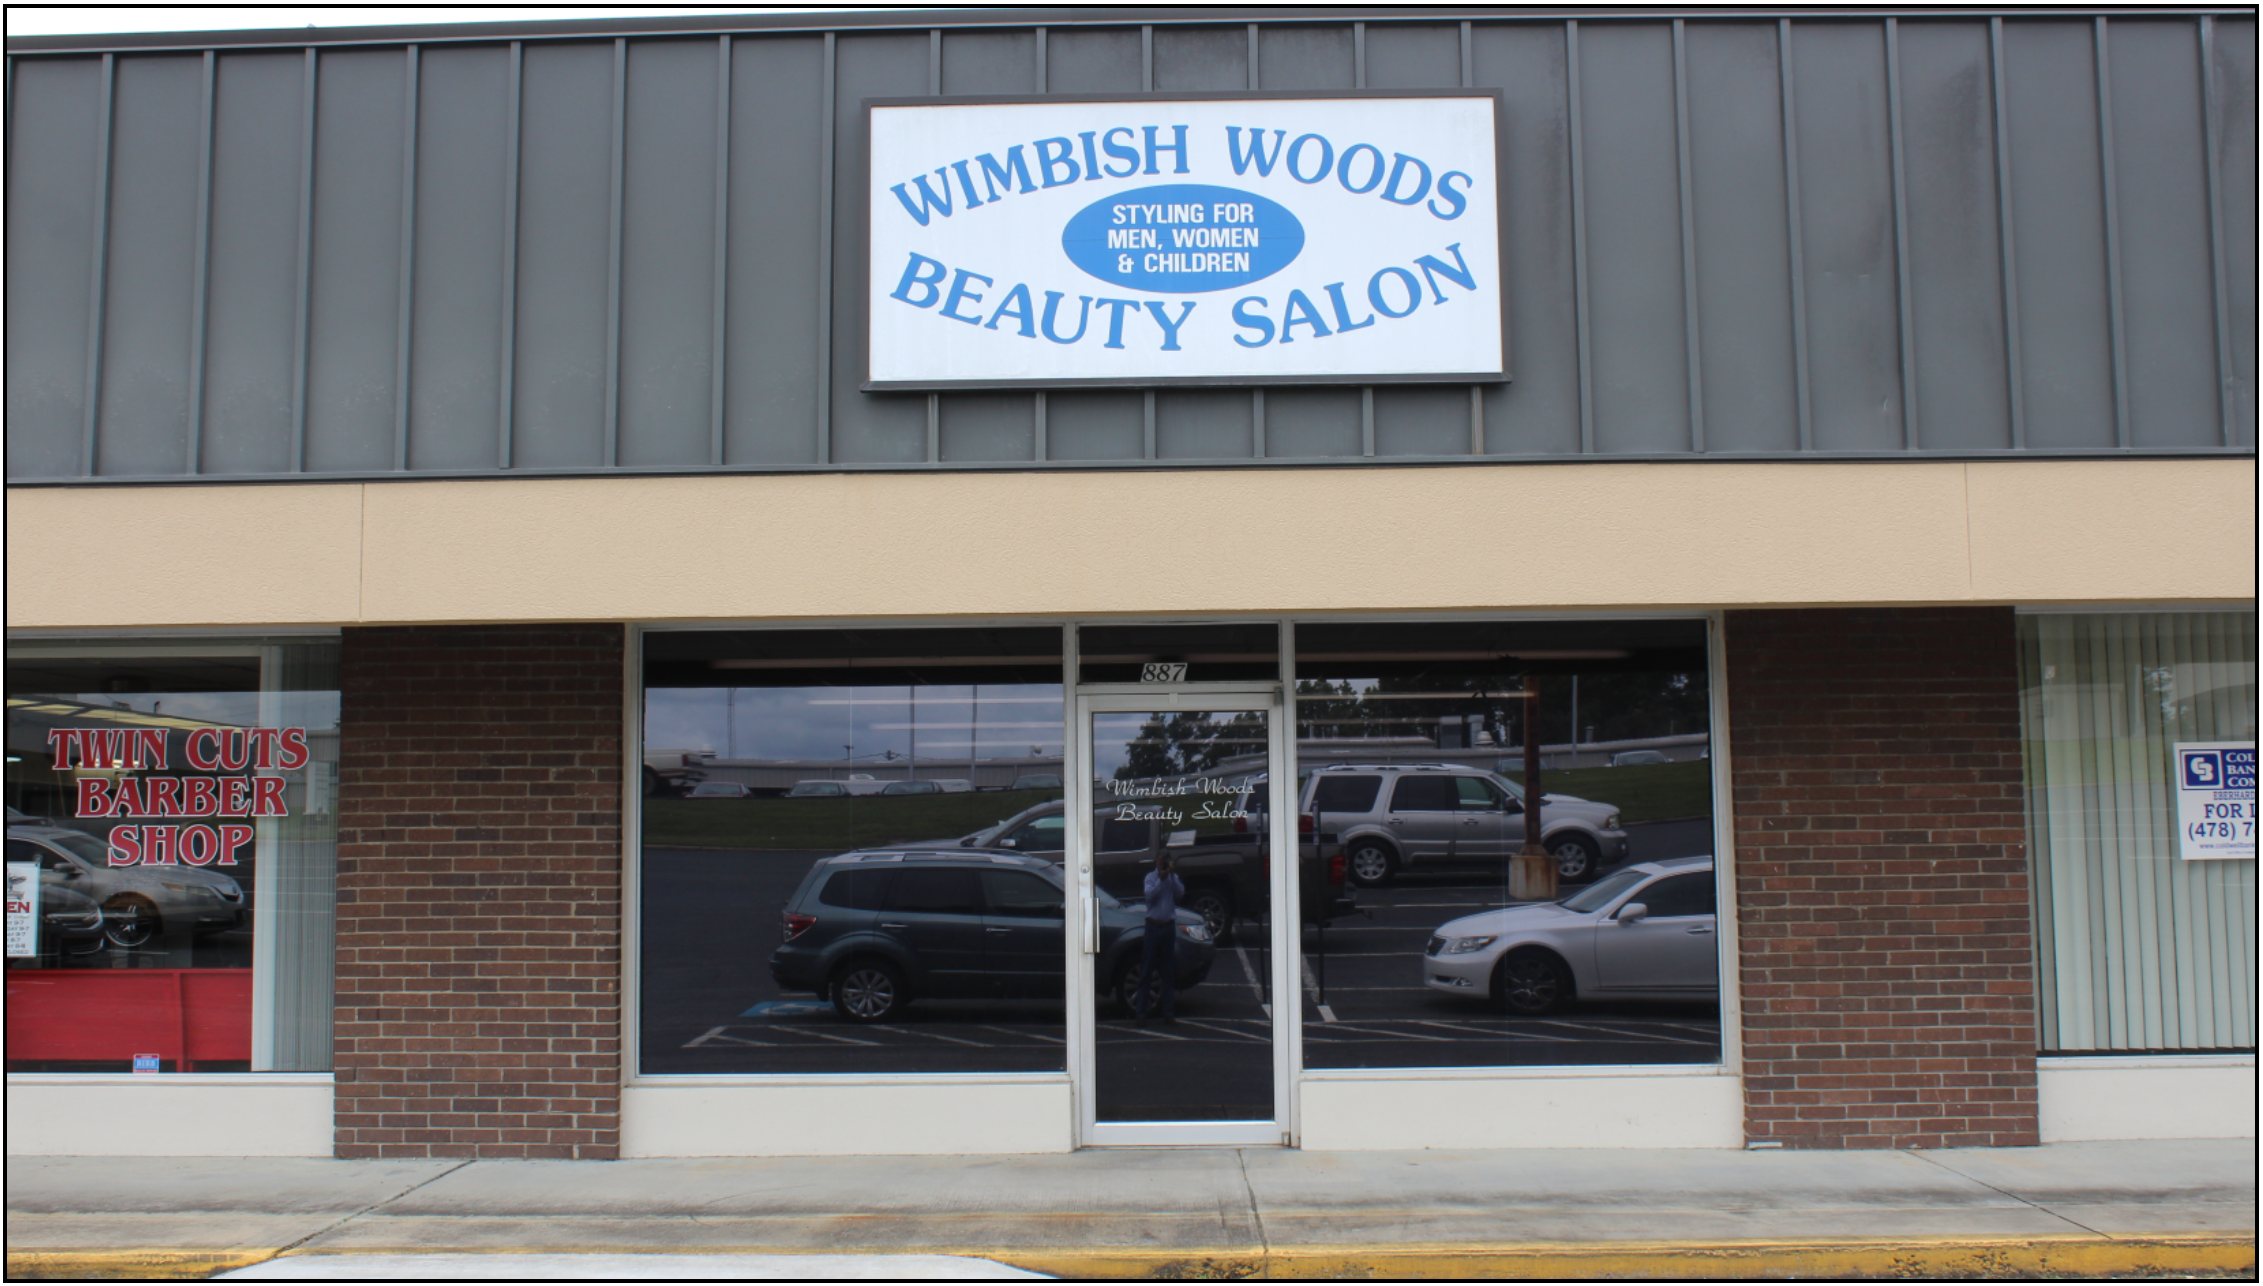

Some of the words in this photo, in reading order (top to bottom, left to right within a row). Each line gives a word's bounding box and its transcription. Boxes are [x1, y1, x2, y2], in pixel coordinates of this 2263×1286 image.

[889, 123, 1191, 226] WIMBISH
[1225, 124, 1474, 221] WOODS
[1112, 203, 1204, 224] STYLING
[1213, 202, 1254, 223] FOR
[1107, 228, 1163, 251] MEN,
[1172, 227, 1259, 248] WOMEN
[1118, 253, 1135, 273] &
[1144, 252, 1250, 273] CHILDREN
[889, 250, 1198, 351] BEAUTY
[1231, 241, 1478, 348] SALON
[1142, 663, 1186, 682] 887
[48, 727, 170, 771] TWIN
[185, 727, 310, 770] CUTS
[75, 775, 288, 817] BARBER
[1106, 777, 1187, 796] Wimbish
[1195, 777, 1255, 795] Woods
[1115, 802, 1183, 826] Beauty
[1191, 800, 1249, 819] Salon
[2204, 803, 2243, 819] FOR
[2188, 822, 2236, 841] (478)
[2242, 822, 2255, 837] 7
[107, 824, 254, 866] SHOP
